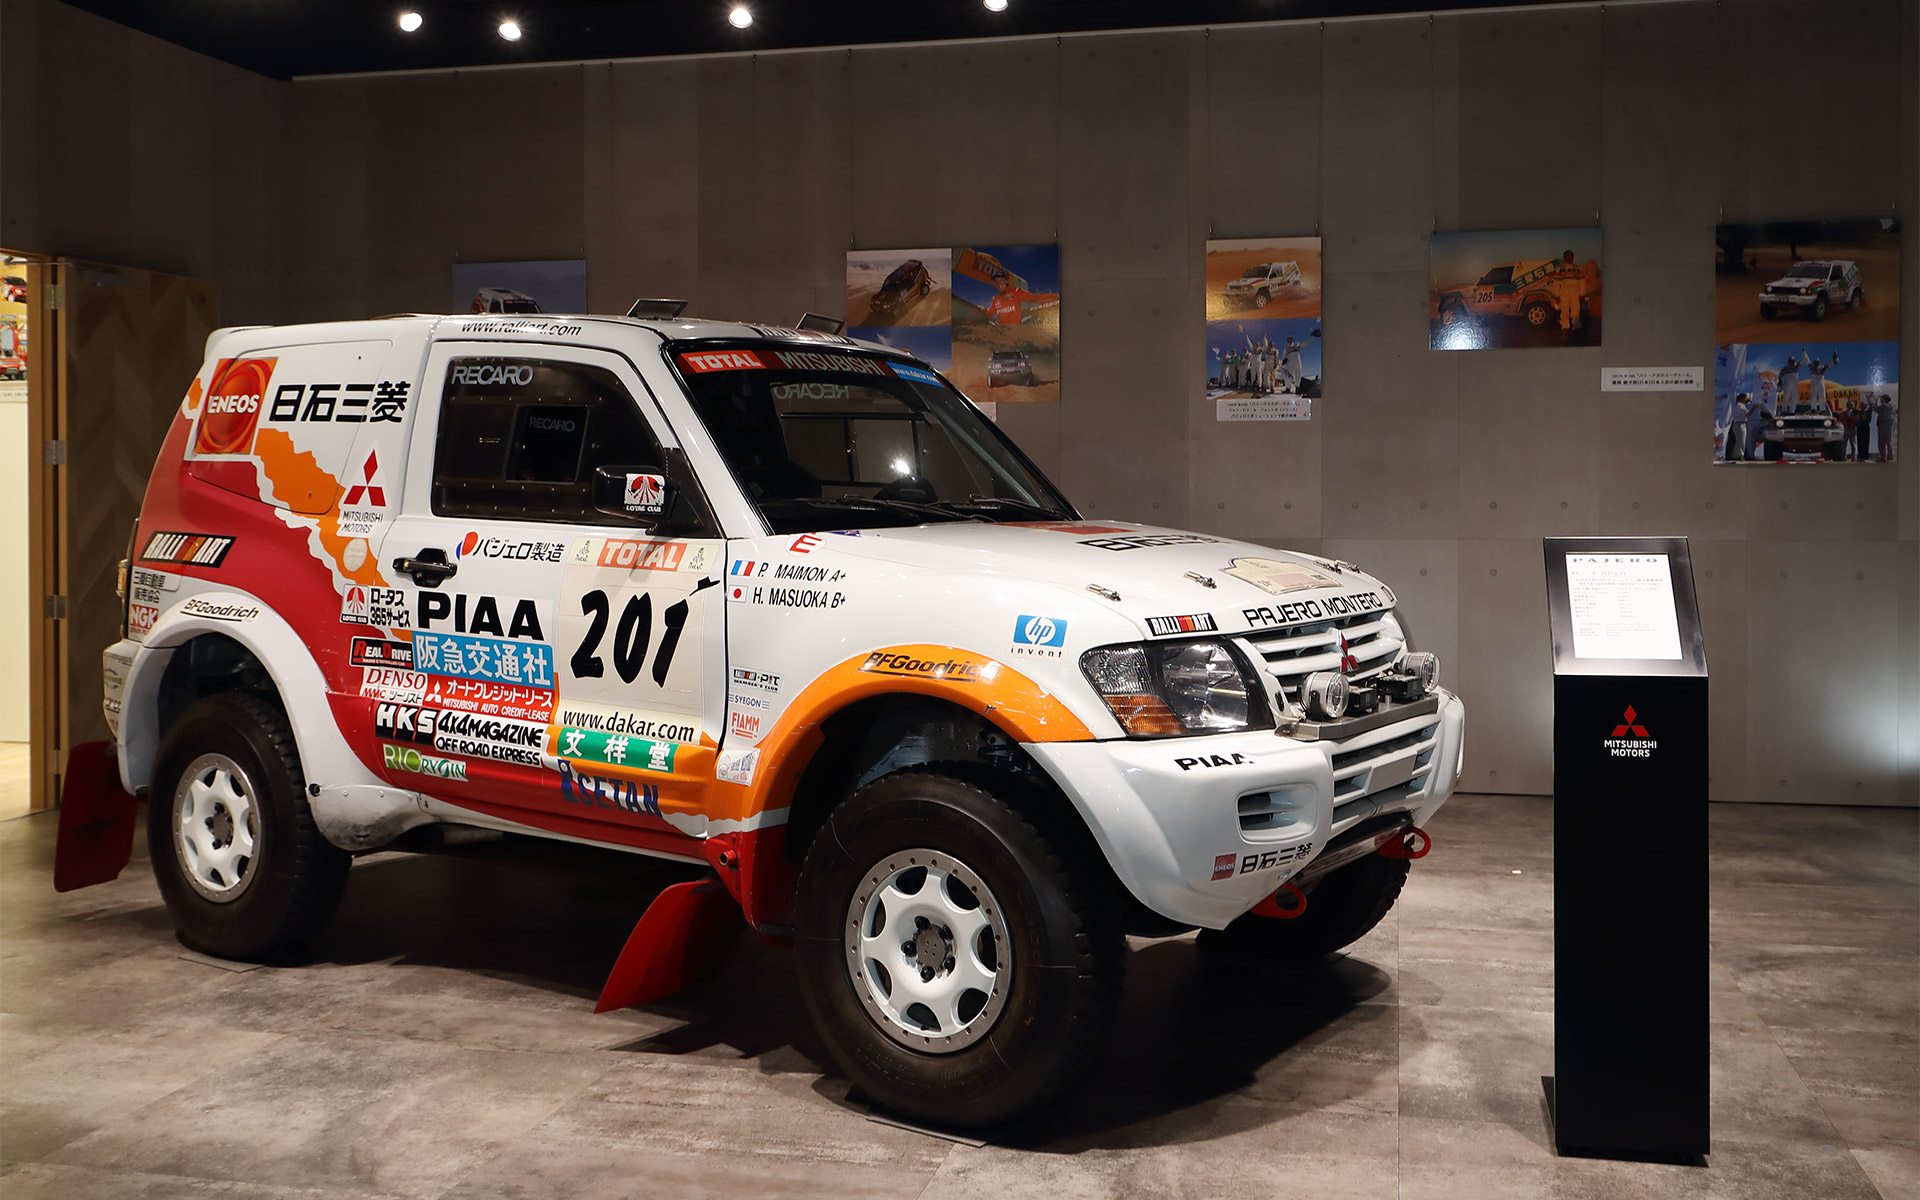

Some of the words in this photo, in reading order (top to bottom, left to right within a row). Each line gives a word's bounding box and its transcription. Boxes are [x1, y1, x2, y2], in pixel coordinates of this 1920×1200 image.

[1477, 292, 1493, 303] 205
[689, 353, 760, 371] TOTAL
[775, 352, 886, 376] MITSUBISHI
[451, 365, 534, 386] RECARO
[207, 394, 260, 414] ENEOS
[268, 380, 411, 423] 日石三菱
[529, 416, 576, 433] RECARO
[342, 510, 383, 524] MITSUBISHI
[342, 522, 373, 534] MOTORS
[473, 537, 565, 562] パジェロ製造
[789, 533, 823, 554] E
[604, 541, 679, 569] TOTAL
[757, 562, 768, 577] P.
[774, 566, 827, 582] MAIMON
[371, 588, 404, 606] ロータス
[753, 587, 764, 604] H.
[768, 588, 828, 608] MASUOKA
[830, 592, 846, 609] B+
[131, 606, 158, 628] NGK
[184, 600, 259, 619] BFGoodrich
[370, 606, 411, 628] 365サービス
[418, 590, 545, 641] PIAA
[1242, 601, 1322, 628] PAJERO
[1320, 592, 1383, 616] MONTERO
[570, 588, 690, 688] 201
[1027, 618, 1053, 645] hp
[415, 634, 551, 686] 阪急交通社
[1010, 645, 1063, 659] invent
[367, 668, 426, 691] DENSO
[362, 688, 386, 699] MMC
[388, 690, 424, 705] ツーリスト
[446, 680, 554, 708] オートクレジット・リース
[734, 694, 762, 708] SYEGON
[376, 704, 438, 734] HKS
[442, 696, 479, 712] MITSUBISHI
[480, 703, 499, 714] AUTO
[501, 706, 550, 722] CREDIT-LEASE
[563, 710, 695, 742] www.dakar.com
[731, 712, 760, 732] FIAMM
[435, 736, 459, 751] OFF
[459, 741, 490, 758] ROAD
[491, 745, 541, 766] EXPRESS
[565, 729, 671, 771] 文祥堂
[1604, 740, 1657, 749] MITSUBISHI
[1611, 749, 1650, 757] MOTORS
[557, 758, 664, 818] ISETAN
[1214, 864, 1235, 872] ENEOS
[1239, 842, 1313, 875] 日石三菱
